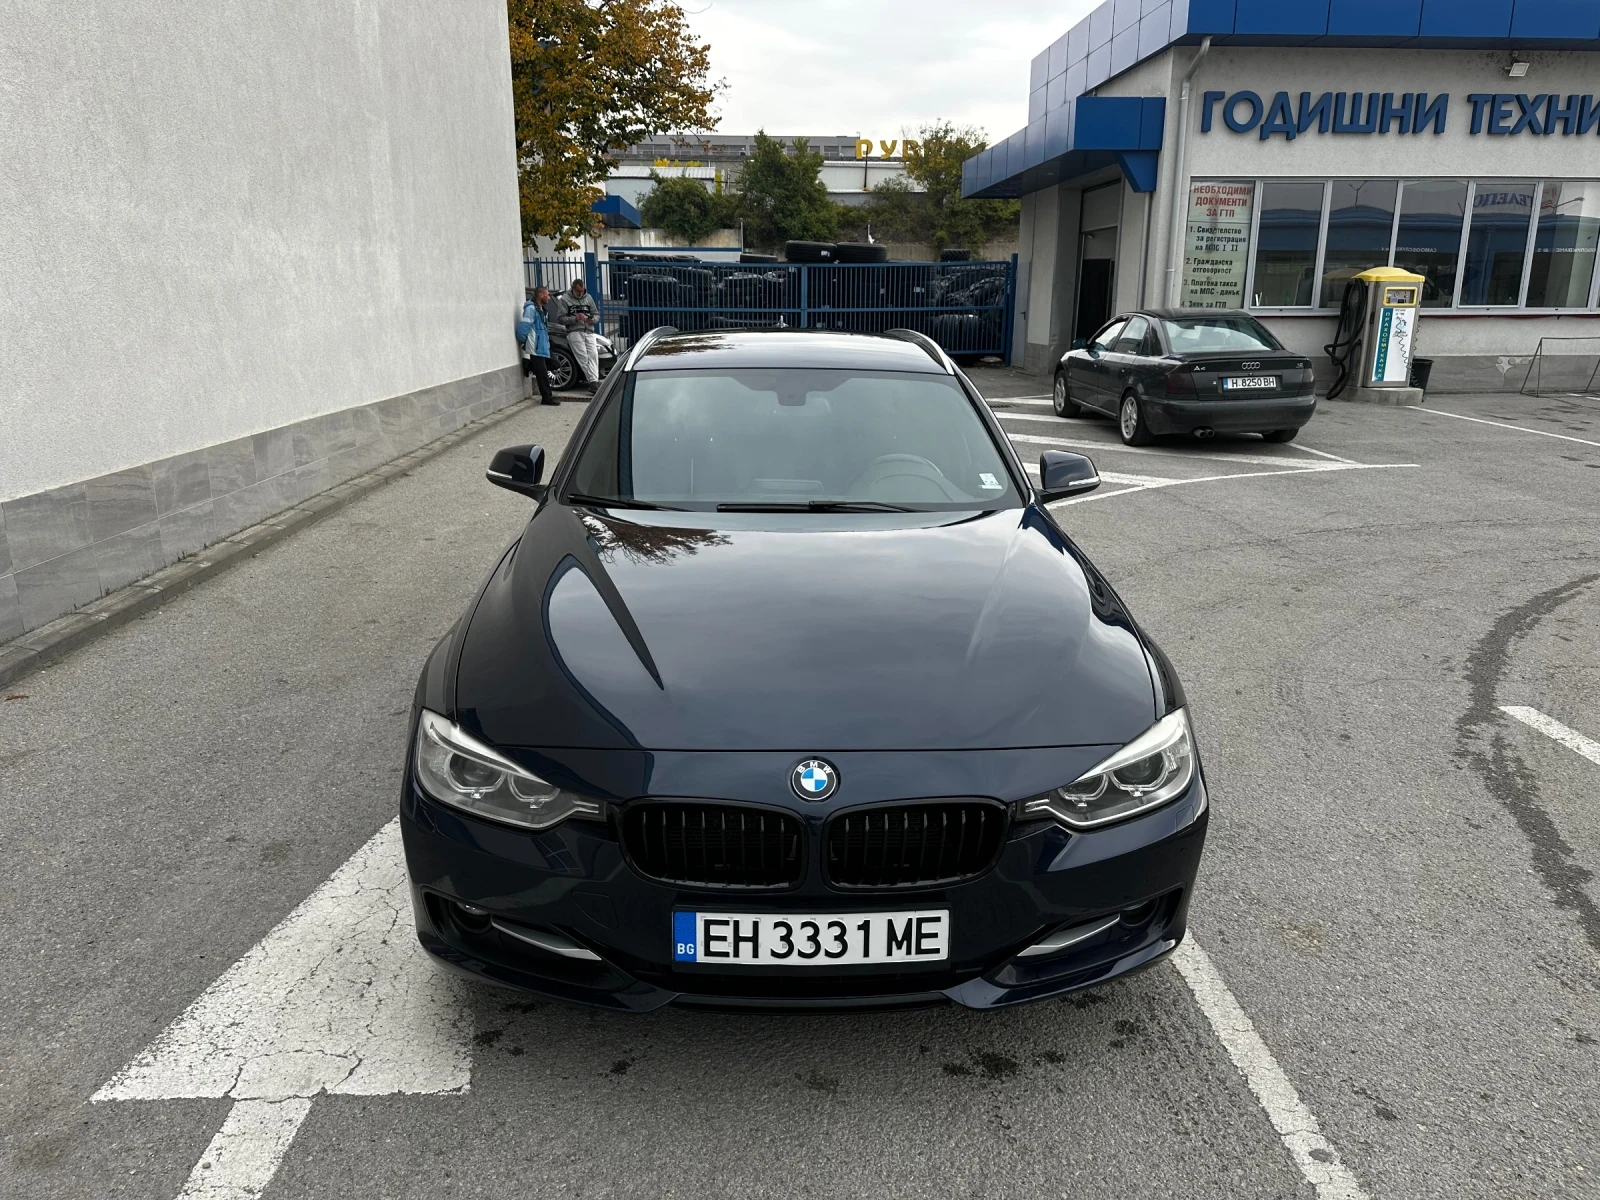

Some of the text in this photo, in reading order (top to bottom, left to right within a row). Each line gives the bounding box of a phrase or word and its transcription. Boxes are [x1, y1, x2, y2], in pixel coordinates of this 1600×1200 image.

[1201, 90, 1600, 141] ГОДИШНИ ТЕХНИ
[1193, 185, 1252, 196] НЕОБХОДИМИ
[1195, 197, 1248, 207] ДОКУМЕНТИ
[1206, 208, 1235, 217] ЗА ГТП
[1197, 226, 1242, 235] Свидетелство
[1205, 236, 1247, 244] регистрация
[1205, 244, 1220, 252] МПС
[1186, 257, 1233, 266] 2. Гражданска
[1192, 267, 1232, 275] отговорност
[1191, 279, 1218, 287] Платена
[1181, 300, 1187, 308] 4.
[1188, 300, 1204, 308] Знак
[1377, 312, 1391, 378] ПРАХОСМУКАЧКА
[1241, 378, 1262, 387] 8250
[796, 761, 832, 774] BMW
[703, 916, 942, 960] EH 3331 ME
[677, 943, 695, 955] BG
